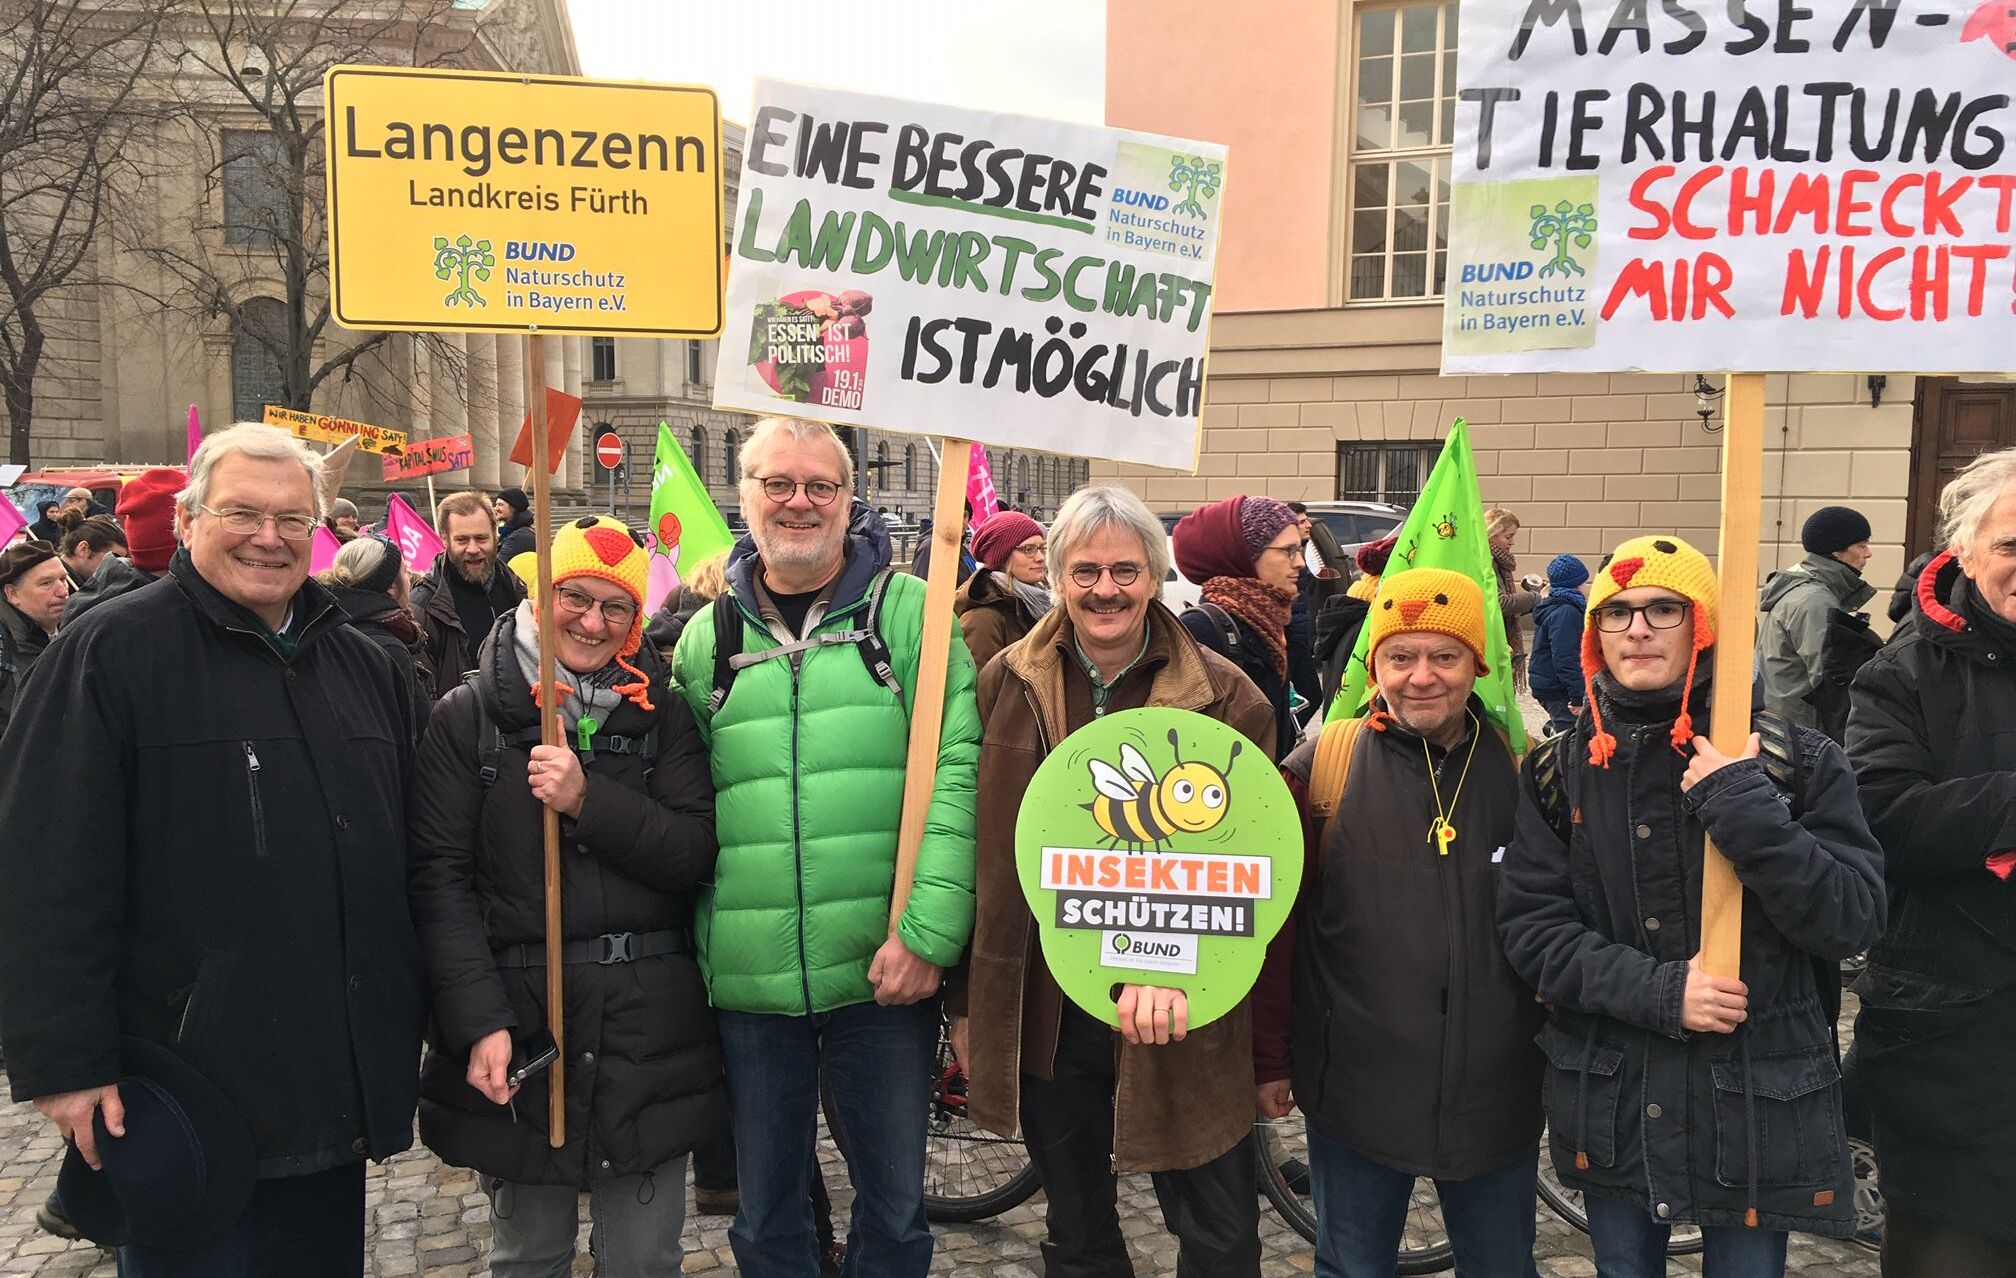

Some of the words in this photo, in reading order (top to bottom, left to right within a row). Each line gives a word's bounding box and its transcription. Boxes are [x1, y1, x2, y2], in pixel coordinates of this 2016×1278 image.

[1459, 82, 2011, 170] TIERHALTUNG
[346, 105, 706, 177] Langenzenn
[748, 105, 890, 189] EINE
[890, 123, 1108, 221] BESSERE
[409, 179, 560, 212] Landkreis
[570, 186, 649, 215] Fürth
[1111, 187, 1170, 211] BUND
[1628, 165, 2016, 241] SCHMECKT
[1109, 208, 1206, 240] Naturschutz
[505, 241, 575, 262] BUND
[1107, 226, 1121, 242] in
[1124, 230, 1176, 253] Bayern
[1179, 244, 1203, 260] e.V.
[738, 188, 1213, 333] LANDWIRTSCHAFT
[1460, 261, 1534, 283] BUND
[506, 267, 625, 288] Naturschutz
[1600, 252, 1736, 323] MIR
[507, 290, 523, 307] in
[529, 291, 593, 313] Bayern
[598, 294, 627, 311] e.V.
[1460, 286, 1586, 307] Naturschutz
[768, 323, 817, 342] ESSEN
[828, 323, 852, 341] IST
[1460, 314, 1477, 330] in
[1483, 313, 1550, 333] Bayern
[1556, 309, 1586, 327] e.V.
[768, 344, 850, 364] POLITISCH!
[821, 387, 861, 409] DEMO
[269, 408, 288, 420] WIR
[289, 412, 317, 425] HABEN
[448, 450, 471, 470] SATT
[1051, 853, 1260, 894] INSEKTEN
[1062, 896, 1244, 931] SCHÜTZEN!
[1132, 941, 1181, 957] BUND
